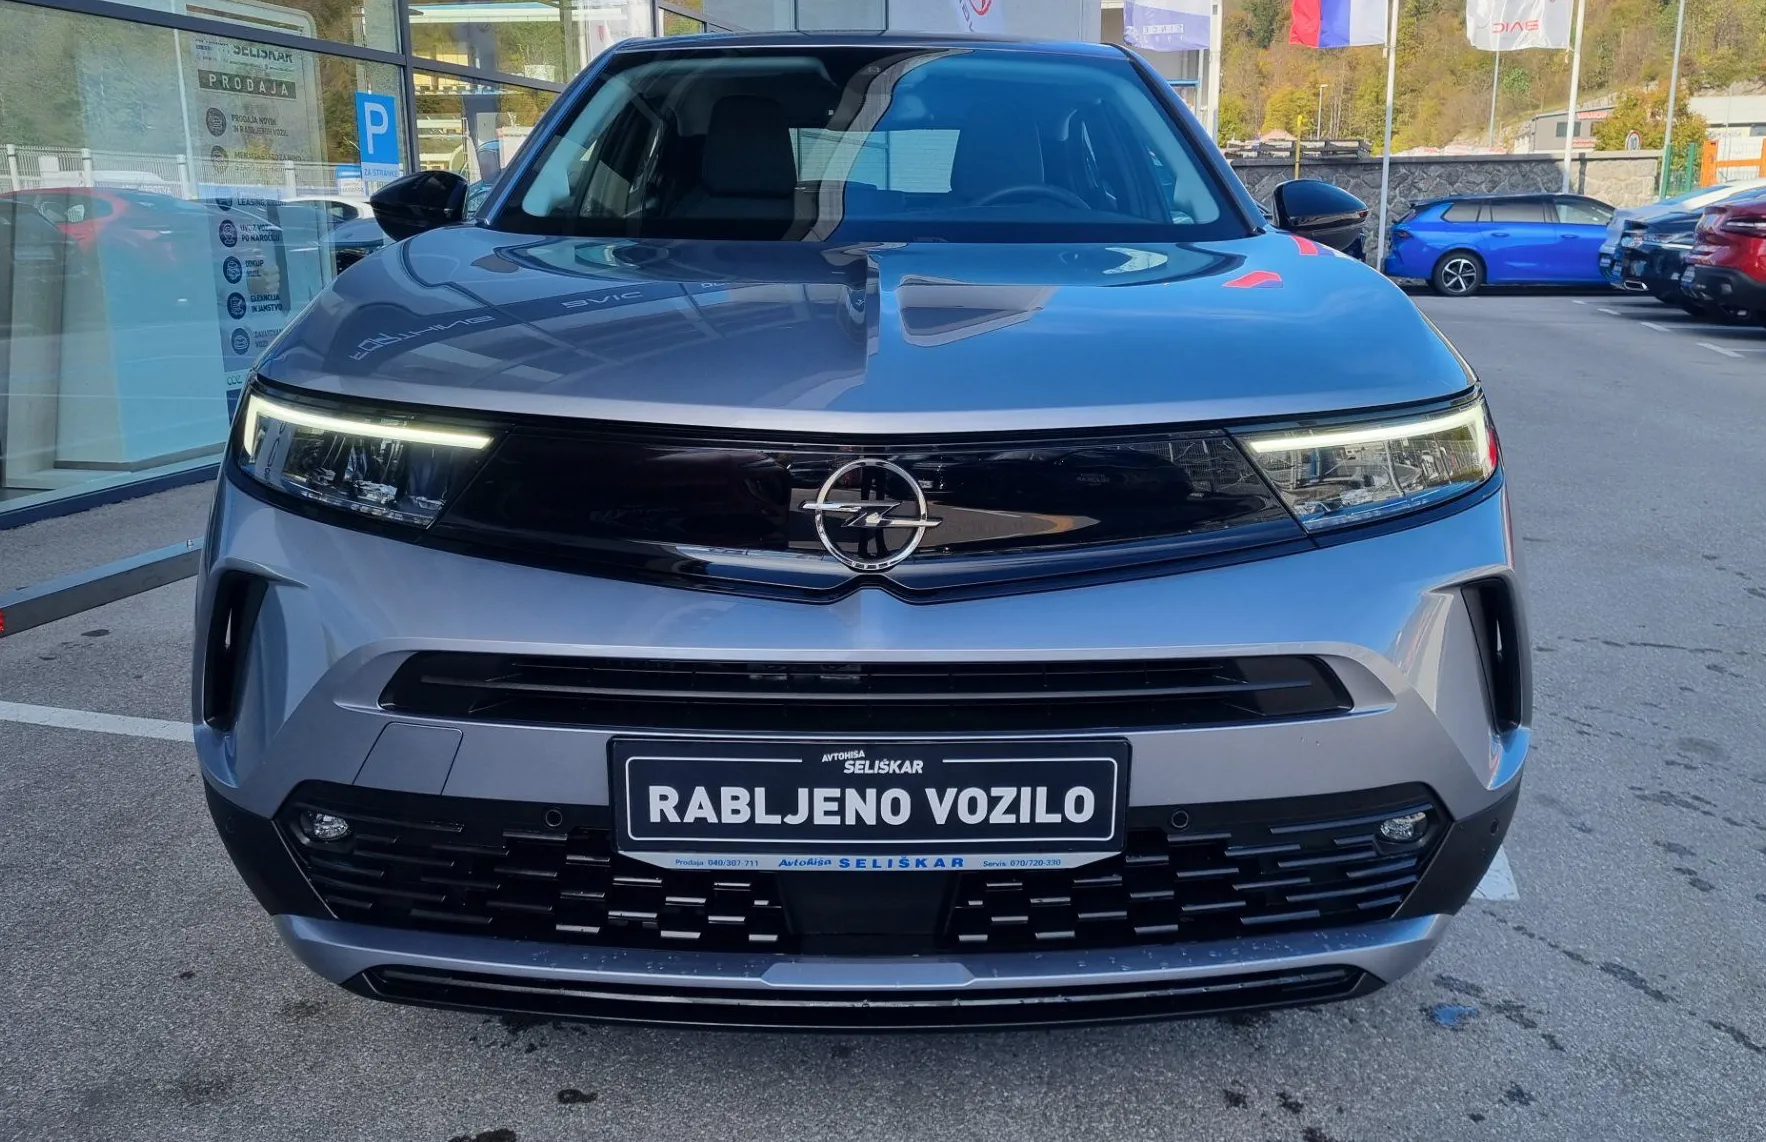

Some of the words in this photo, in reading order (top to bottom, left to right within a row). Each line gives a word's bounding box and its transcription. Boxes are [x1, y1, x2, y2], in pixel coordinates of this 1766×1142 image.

[208, 75, 289, 96] PRODAJA
[364, 102, 389, 154] P
[844, 759, 924, 774] SELIŠKAR
[648, 785, 912, 826] RABLJENO
[925, 785, 1095, 825] VOZILO
[838, 855, 965, 869] SELIŠKAR
